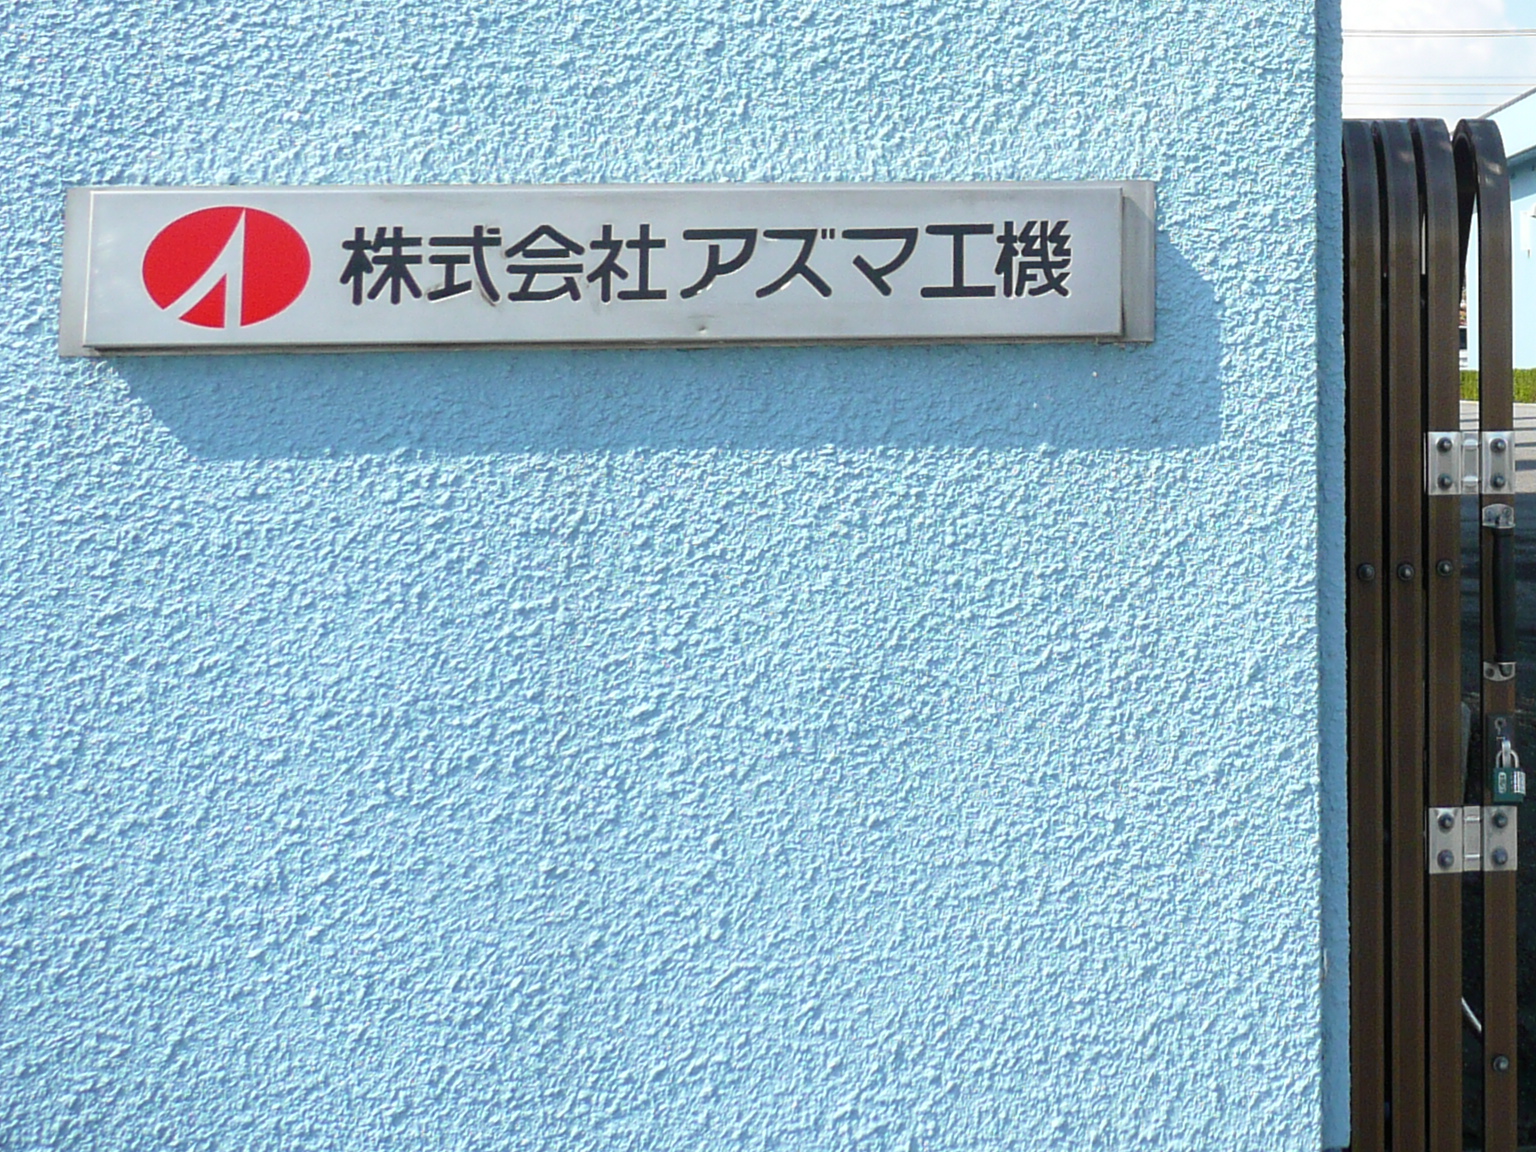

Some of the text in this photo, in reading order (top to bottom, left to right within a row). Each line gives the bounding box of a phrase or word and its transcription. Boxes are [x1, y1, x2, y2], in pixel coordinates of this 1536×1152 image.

[339, 220, 1072, 306] 株式会社アズマ工機
